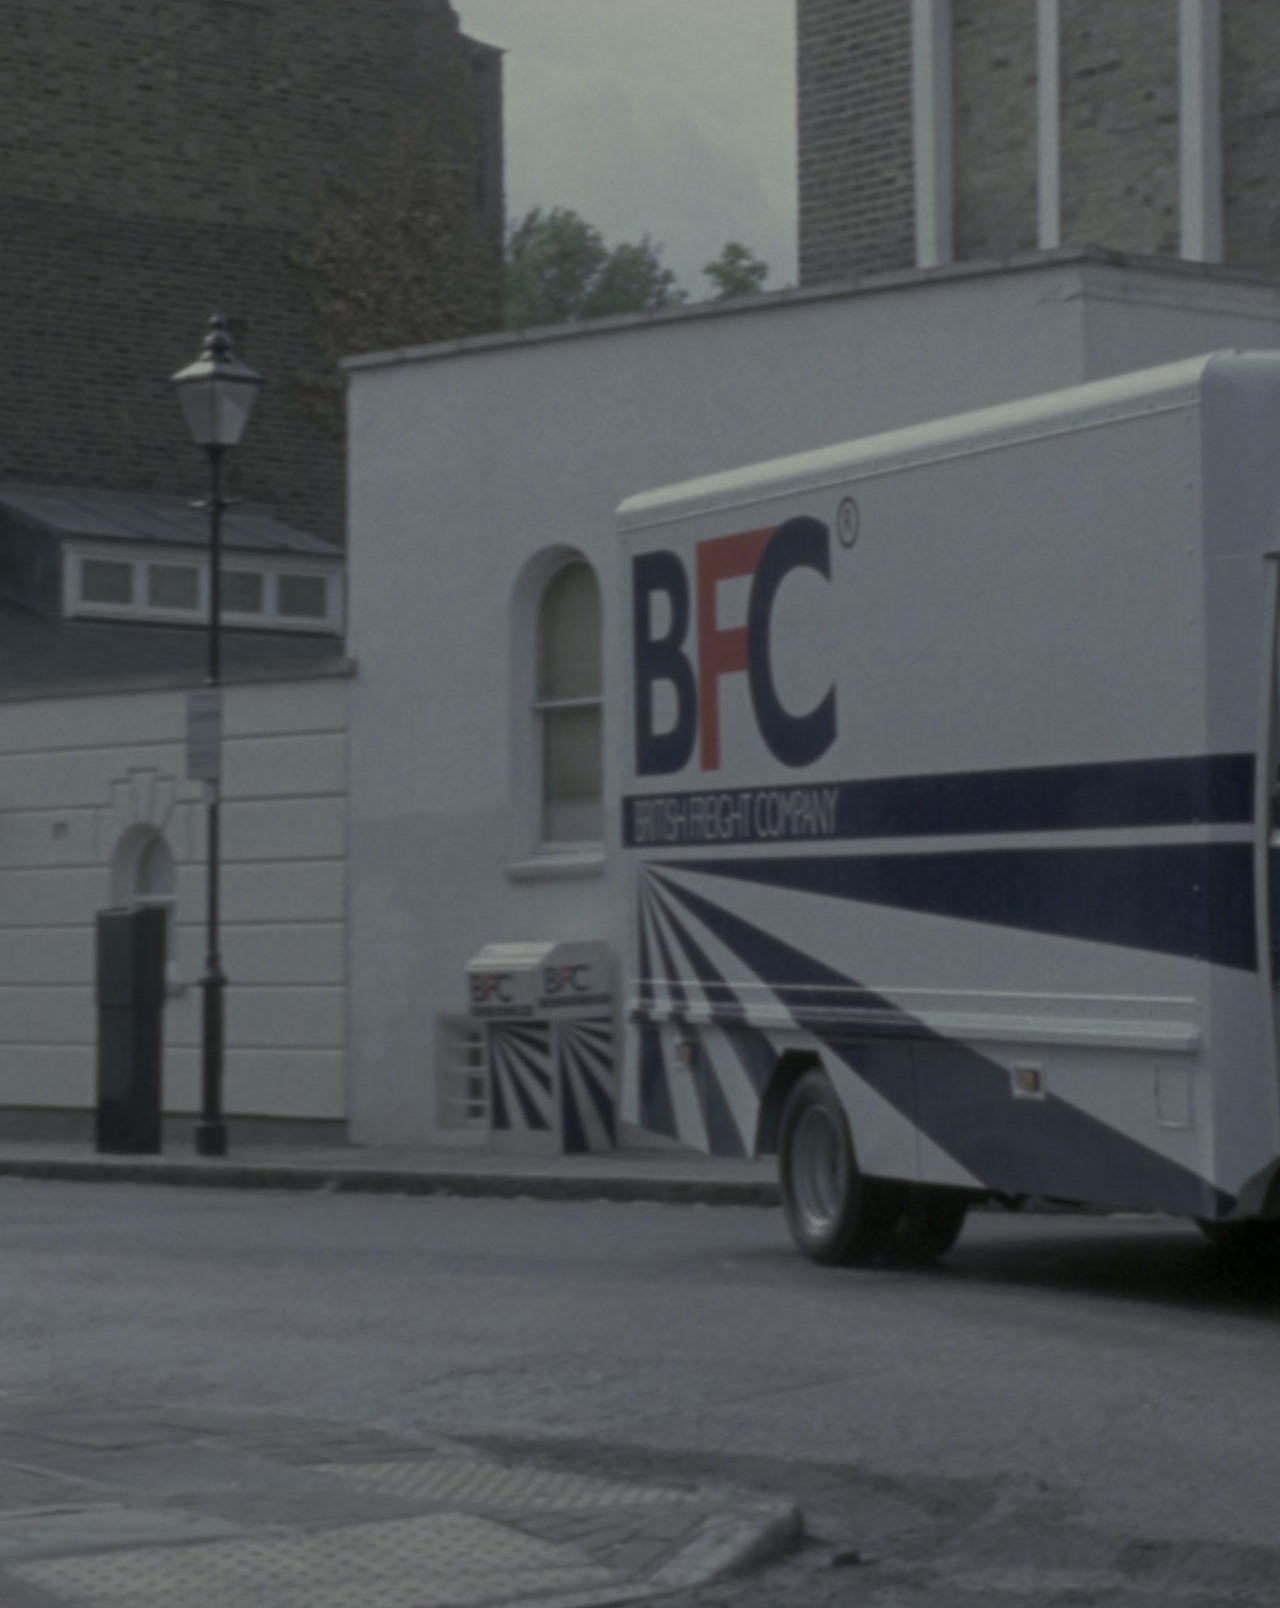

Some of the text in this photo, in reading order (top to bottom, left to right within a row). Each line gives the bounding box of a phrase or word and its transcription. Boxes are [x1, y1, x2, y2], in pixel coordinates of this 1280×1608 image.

[632, 515, 838, 777] BFC
[633, 786, 839, 842] BRITISH FREIGHT COMPANY
[471, 973, 514, 1002] BFC
[544, 964, 590, 994] BFC
